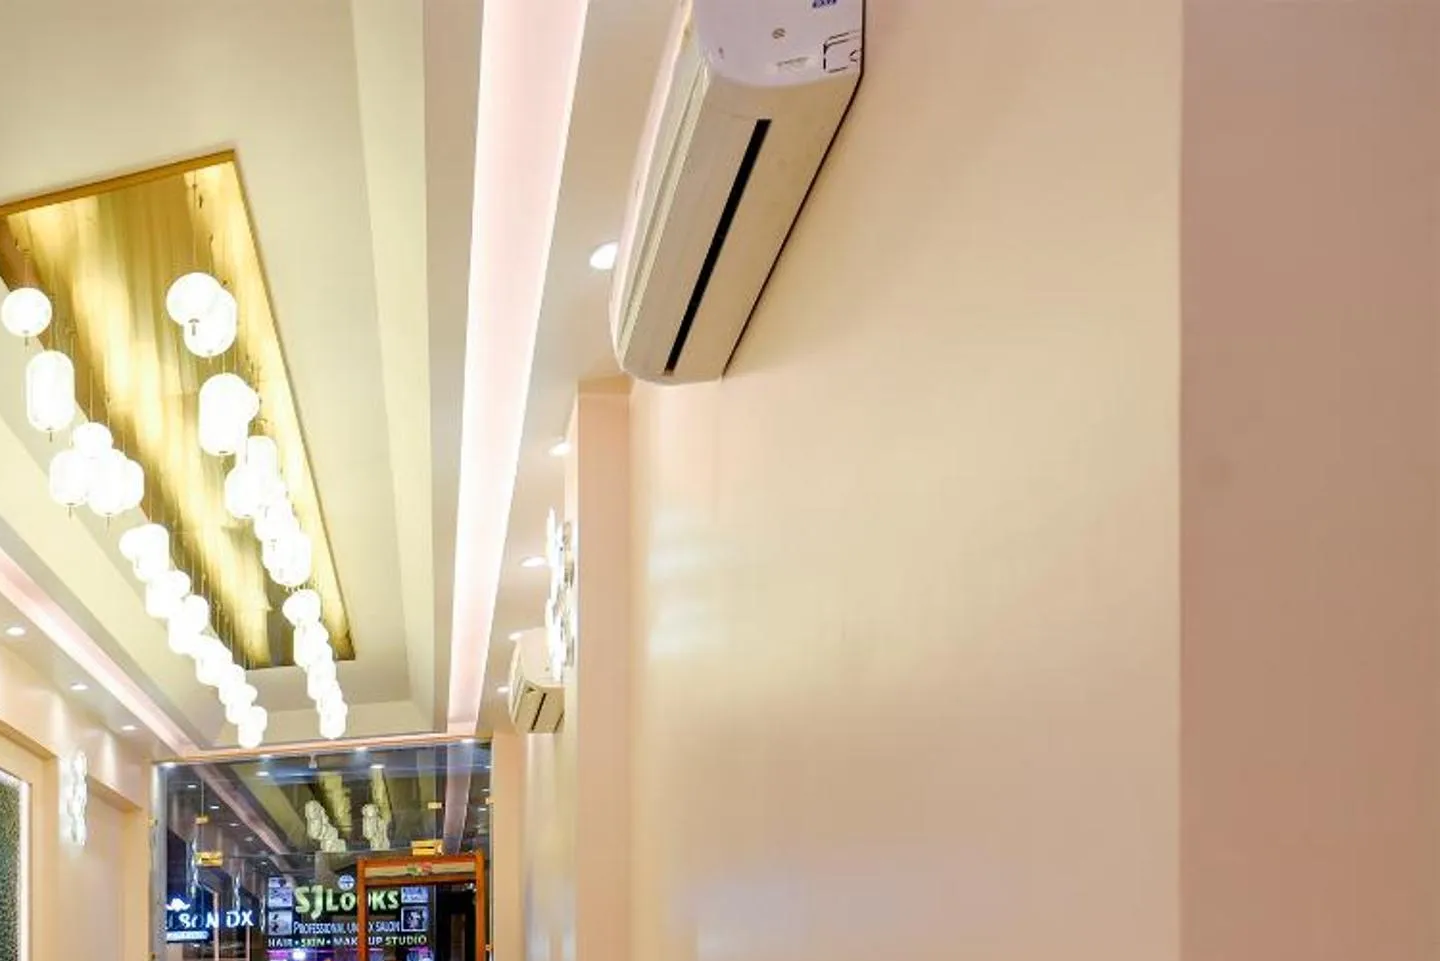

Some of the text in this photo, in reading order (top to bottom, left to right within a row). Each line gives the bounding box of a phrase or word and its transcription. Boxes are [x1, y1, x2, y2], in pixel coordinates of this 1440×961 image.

[267, 938, 293, 947] HAIR
[301, 937, 325, 947] SKIN
[385, 935, 427, 946] STUDIO
